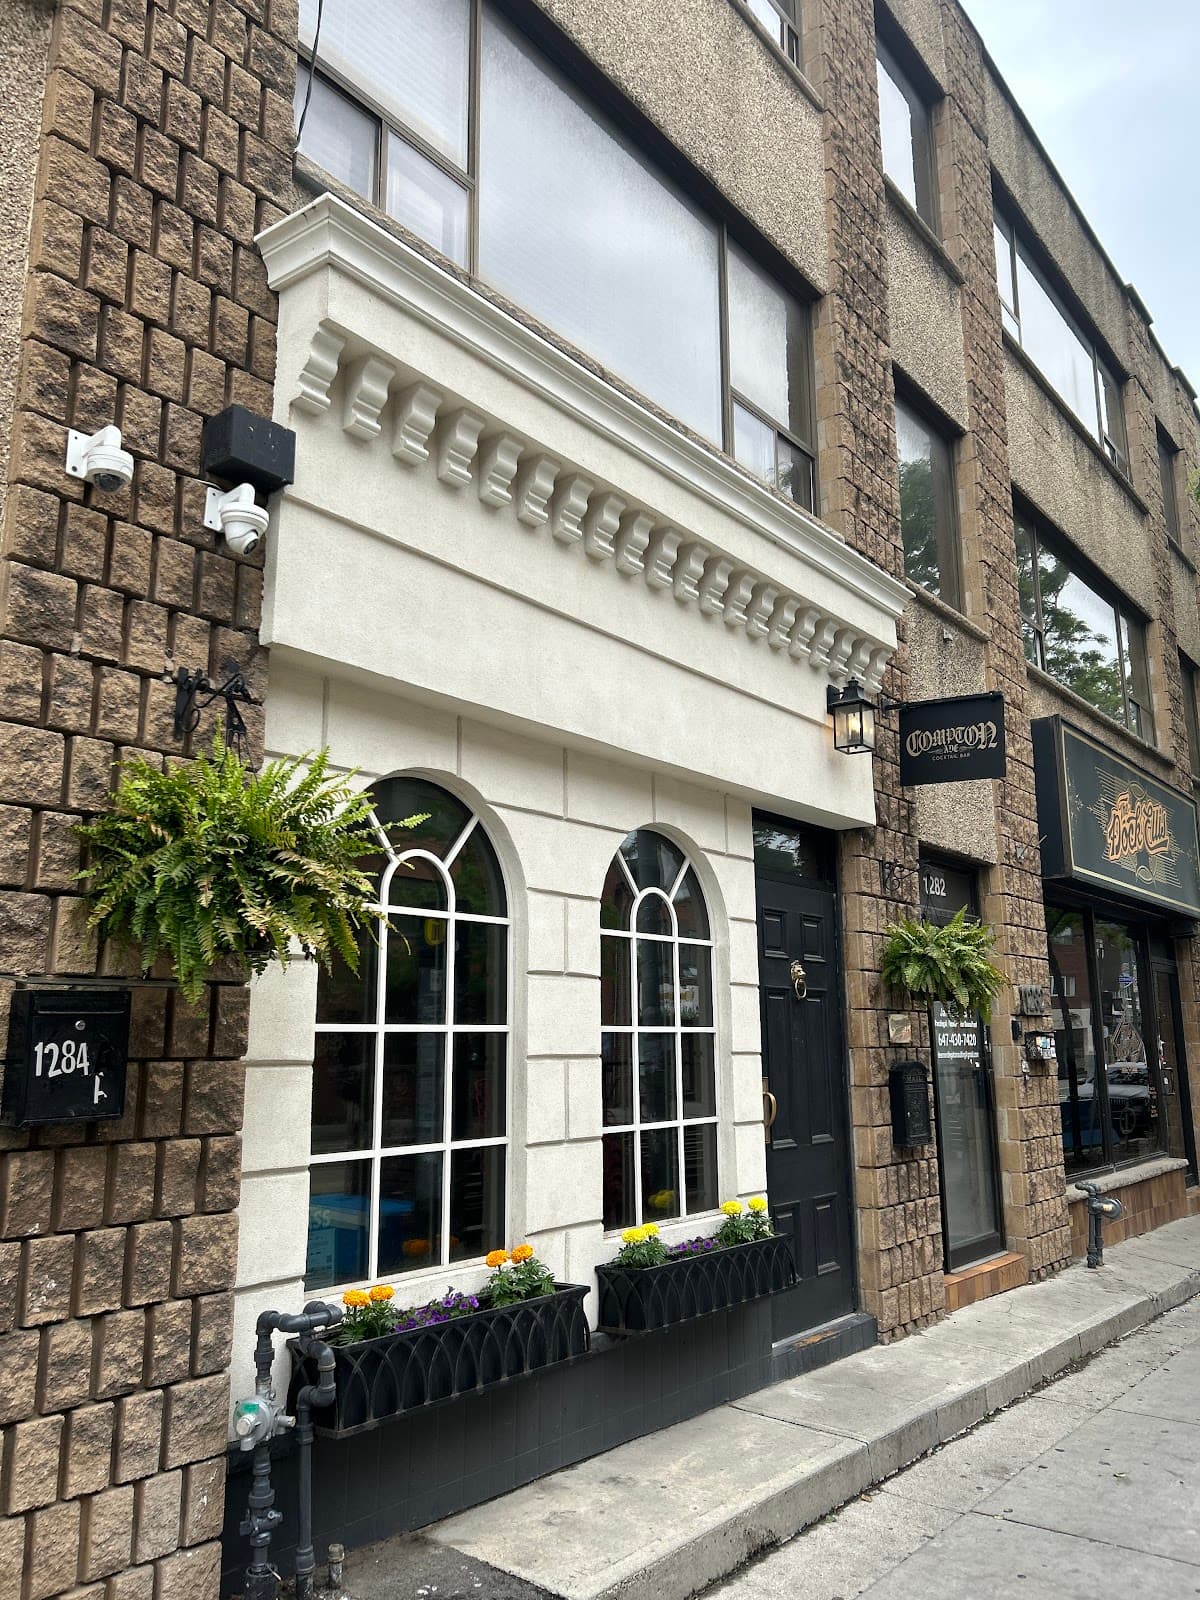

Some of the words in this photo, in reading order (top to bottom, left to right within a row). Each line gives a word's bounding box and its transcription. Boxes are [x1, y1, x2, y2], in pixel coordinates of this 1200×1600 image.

[906, 721, 998, 757] COMPTON
[923, 876, 947, 897] 1282
[938, 1033, 977, 1047] 647-430-7420
[34, 1040, 90, 1078] 1284
